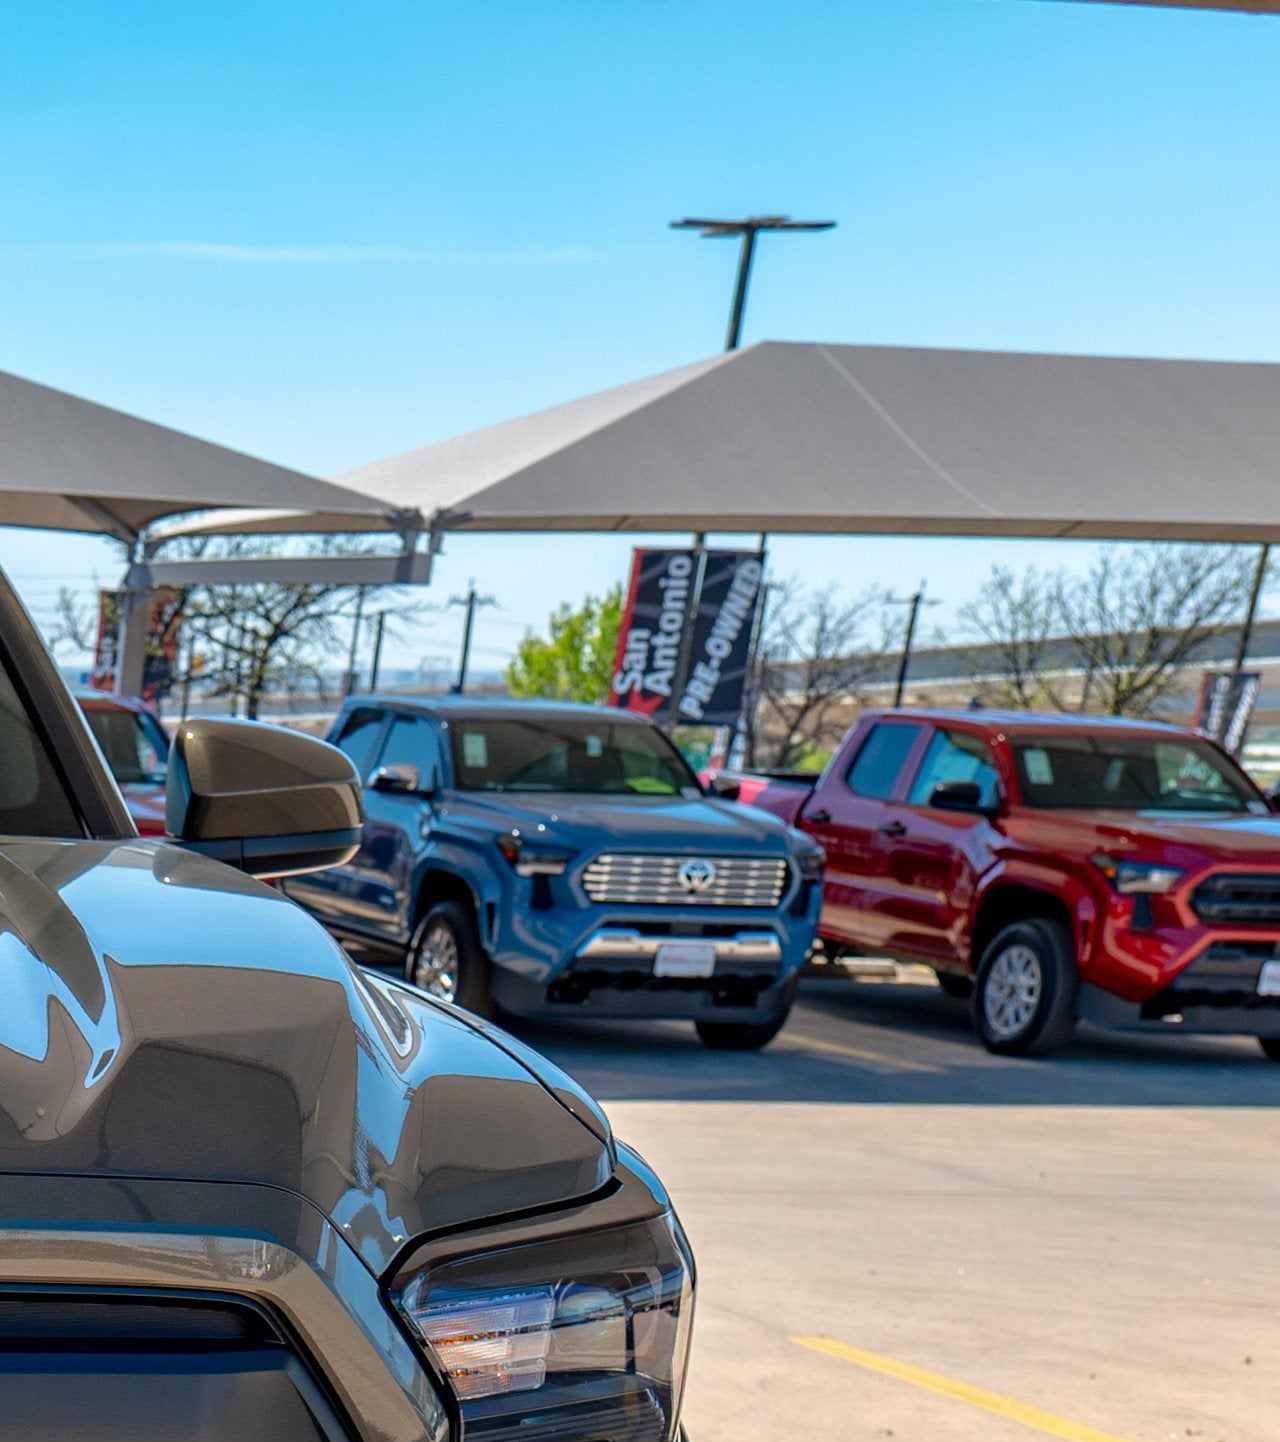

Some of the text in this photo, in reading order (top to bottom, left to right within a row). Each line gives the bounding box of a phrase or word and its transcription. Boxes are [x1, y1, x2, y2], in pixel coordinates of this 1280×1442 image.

[612, 628, 652, 694] San
[642, 554, 693, 697] Antonio
[678, 559, 762, 720] PRE-OWNED
